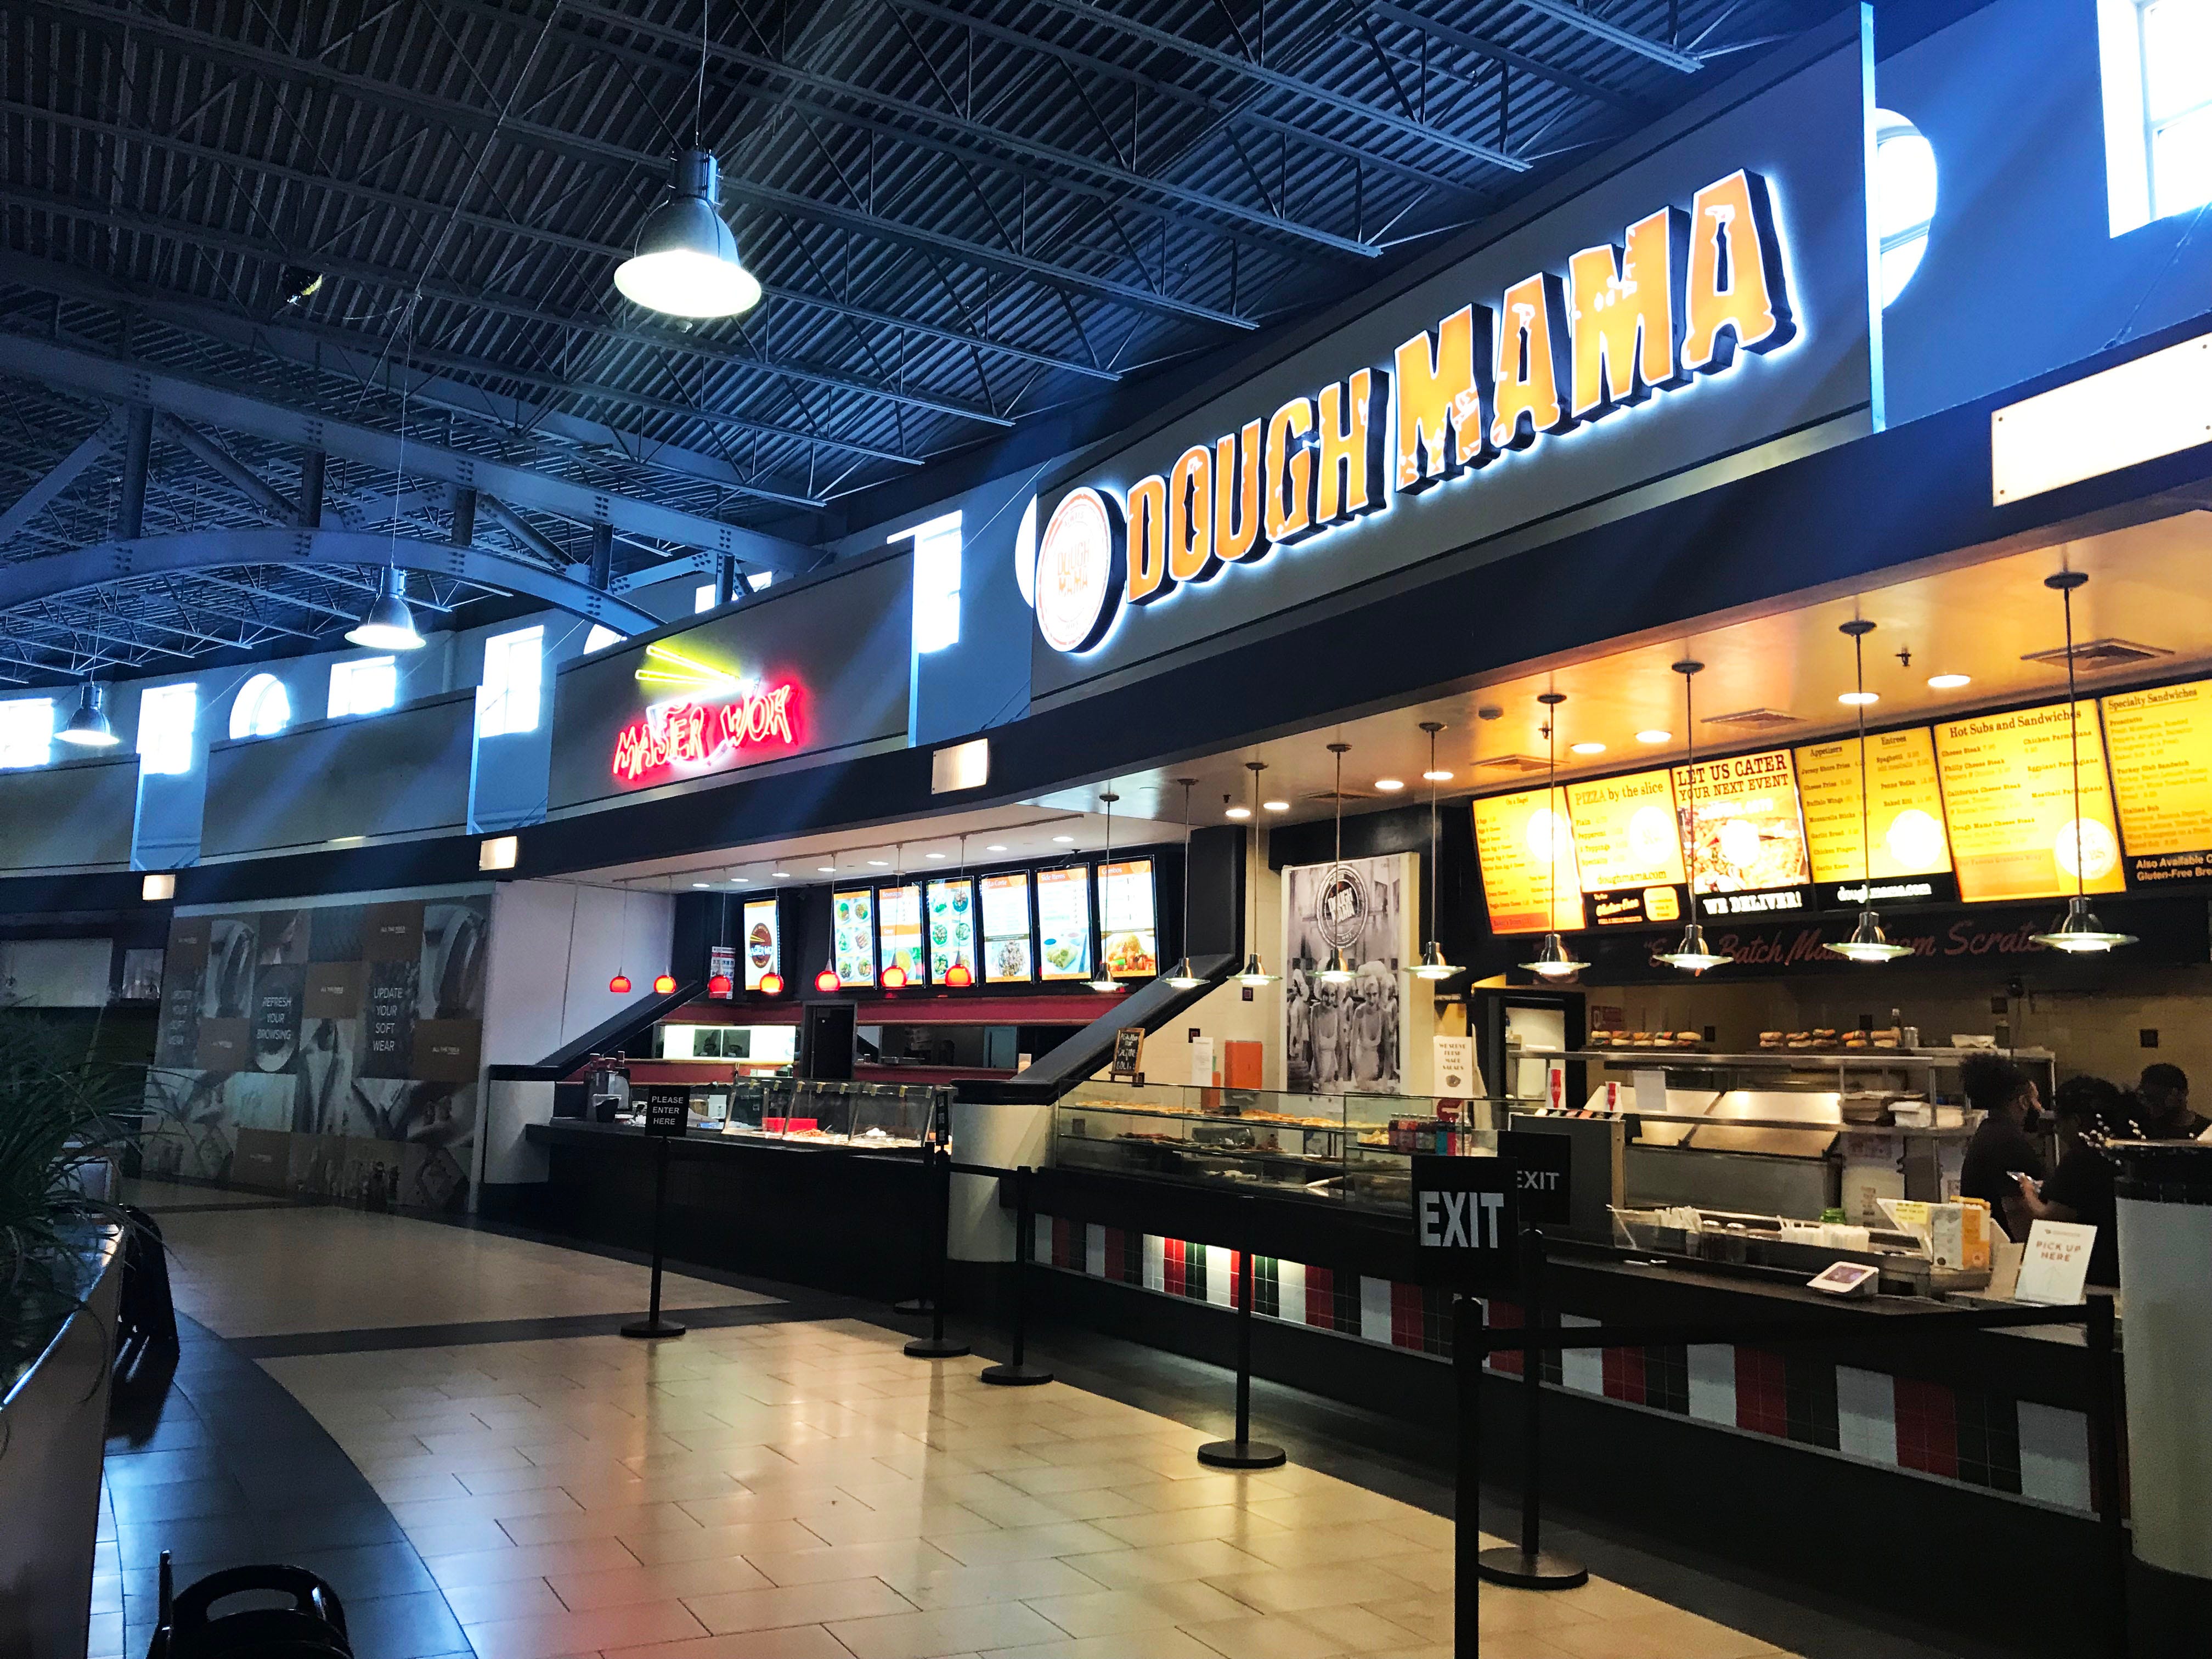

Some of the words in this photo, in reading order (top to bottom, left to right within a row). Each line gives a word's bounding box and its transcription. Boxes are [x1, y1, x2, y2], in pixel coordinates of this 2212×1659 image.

[1126, 366, 1386, 605] DOUGH
[1395, 168, 1796, 492] MAMA
[1058, 540, 1089, 576] DOUGH
[2108, 696, 2146, 712] Specialty
[2147, 688, 2198, 703] Sandwiches
[613, 702, 708, 780] MASTER
[720, 684, 792, 746] WOK
[1950, 727, 1968, 738] Hot
[1970, 723, 1994, 735] Subs
[1996, 718, 2016, 730] and
[1881, 735, 1907, 746] Entrees
[2023, 737, 2050, 745] Chicken
[2052, 731, 2092, 741] Parmiiana
[1810, 746, 1843, 758] Appetizers
[1963, 746, 1982, 754] Steak
[1677, 768, 1705, 787] LET
[1709, 763, 1730, 781] US
[1735, 754, 1787, 777] CATER
[2027, 763, 2057, 772] Eggplant
[2058, 758, 2098, 768] Parmgiana
[2158, 761, 2190, 769] Sandwich
[1575, 789, 1607, 806] PIZZA
[1607, 788, 1620, 802] by
[1622, 785, 1639, 798] the
[1640, 782, 1664, 795] slice
[1679, 786, 1711, 802] YOUR
[1712, 780, 1745, 796] NEXT
[1747, 773, 1788, 791] EVENT
[1947, 788, 1979, 797] California
[2032, 789, 2061, 798] Meatball
[1577, 830, 1607, 840] Pepperoni
[2136, 859, 2158, 870] Also
[2159, 855, 2204, 867] Available
[1597, 870, 1667, 885] doughmama.com
[2137, 868, 2193, 881] Gluten-Free
[1702, 897, 1729, 915] WE
[1729, 891, 1802, 913] DELIVER!
[1719, 929, 1784, 964] Batch
[1784, 927, 1850, 966] Ma
[1944, 918, 2062, 956] Scratc
[373, 988, 403, 999] UPDATE
[262, 996, 292, 1007] REFRESH
[376, 1005, 398, 1017] YOUR
[267, 1013, 285, 1023] YOUR
[256, 1029, 292, 1040] BROWSING
[375, 1023, 396, 1034] SOFT
[373, 1040, 395, 1052] WEAR
[651, 1096, 684, 1104] PLEASE
[652, 1106, 680, 1114] ENTER
[1517, 1170, 1560, 1190] EXIT
[1419, 1191, 1504, 1249] EXIT
[2036, 1240, 2062, 1251] PICK
[2066, 1244, 2081, 1253] UP
[2040, 1251, 2072, 1262] HERE
